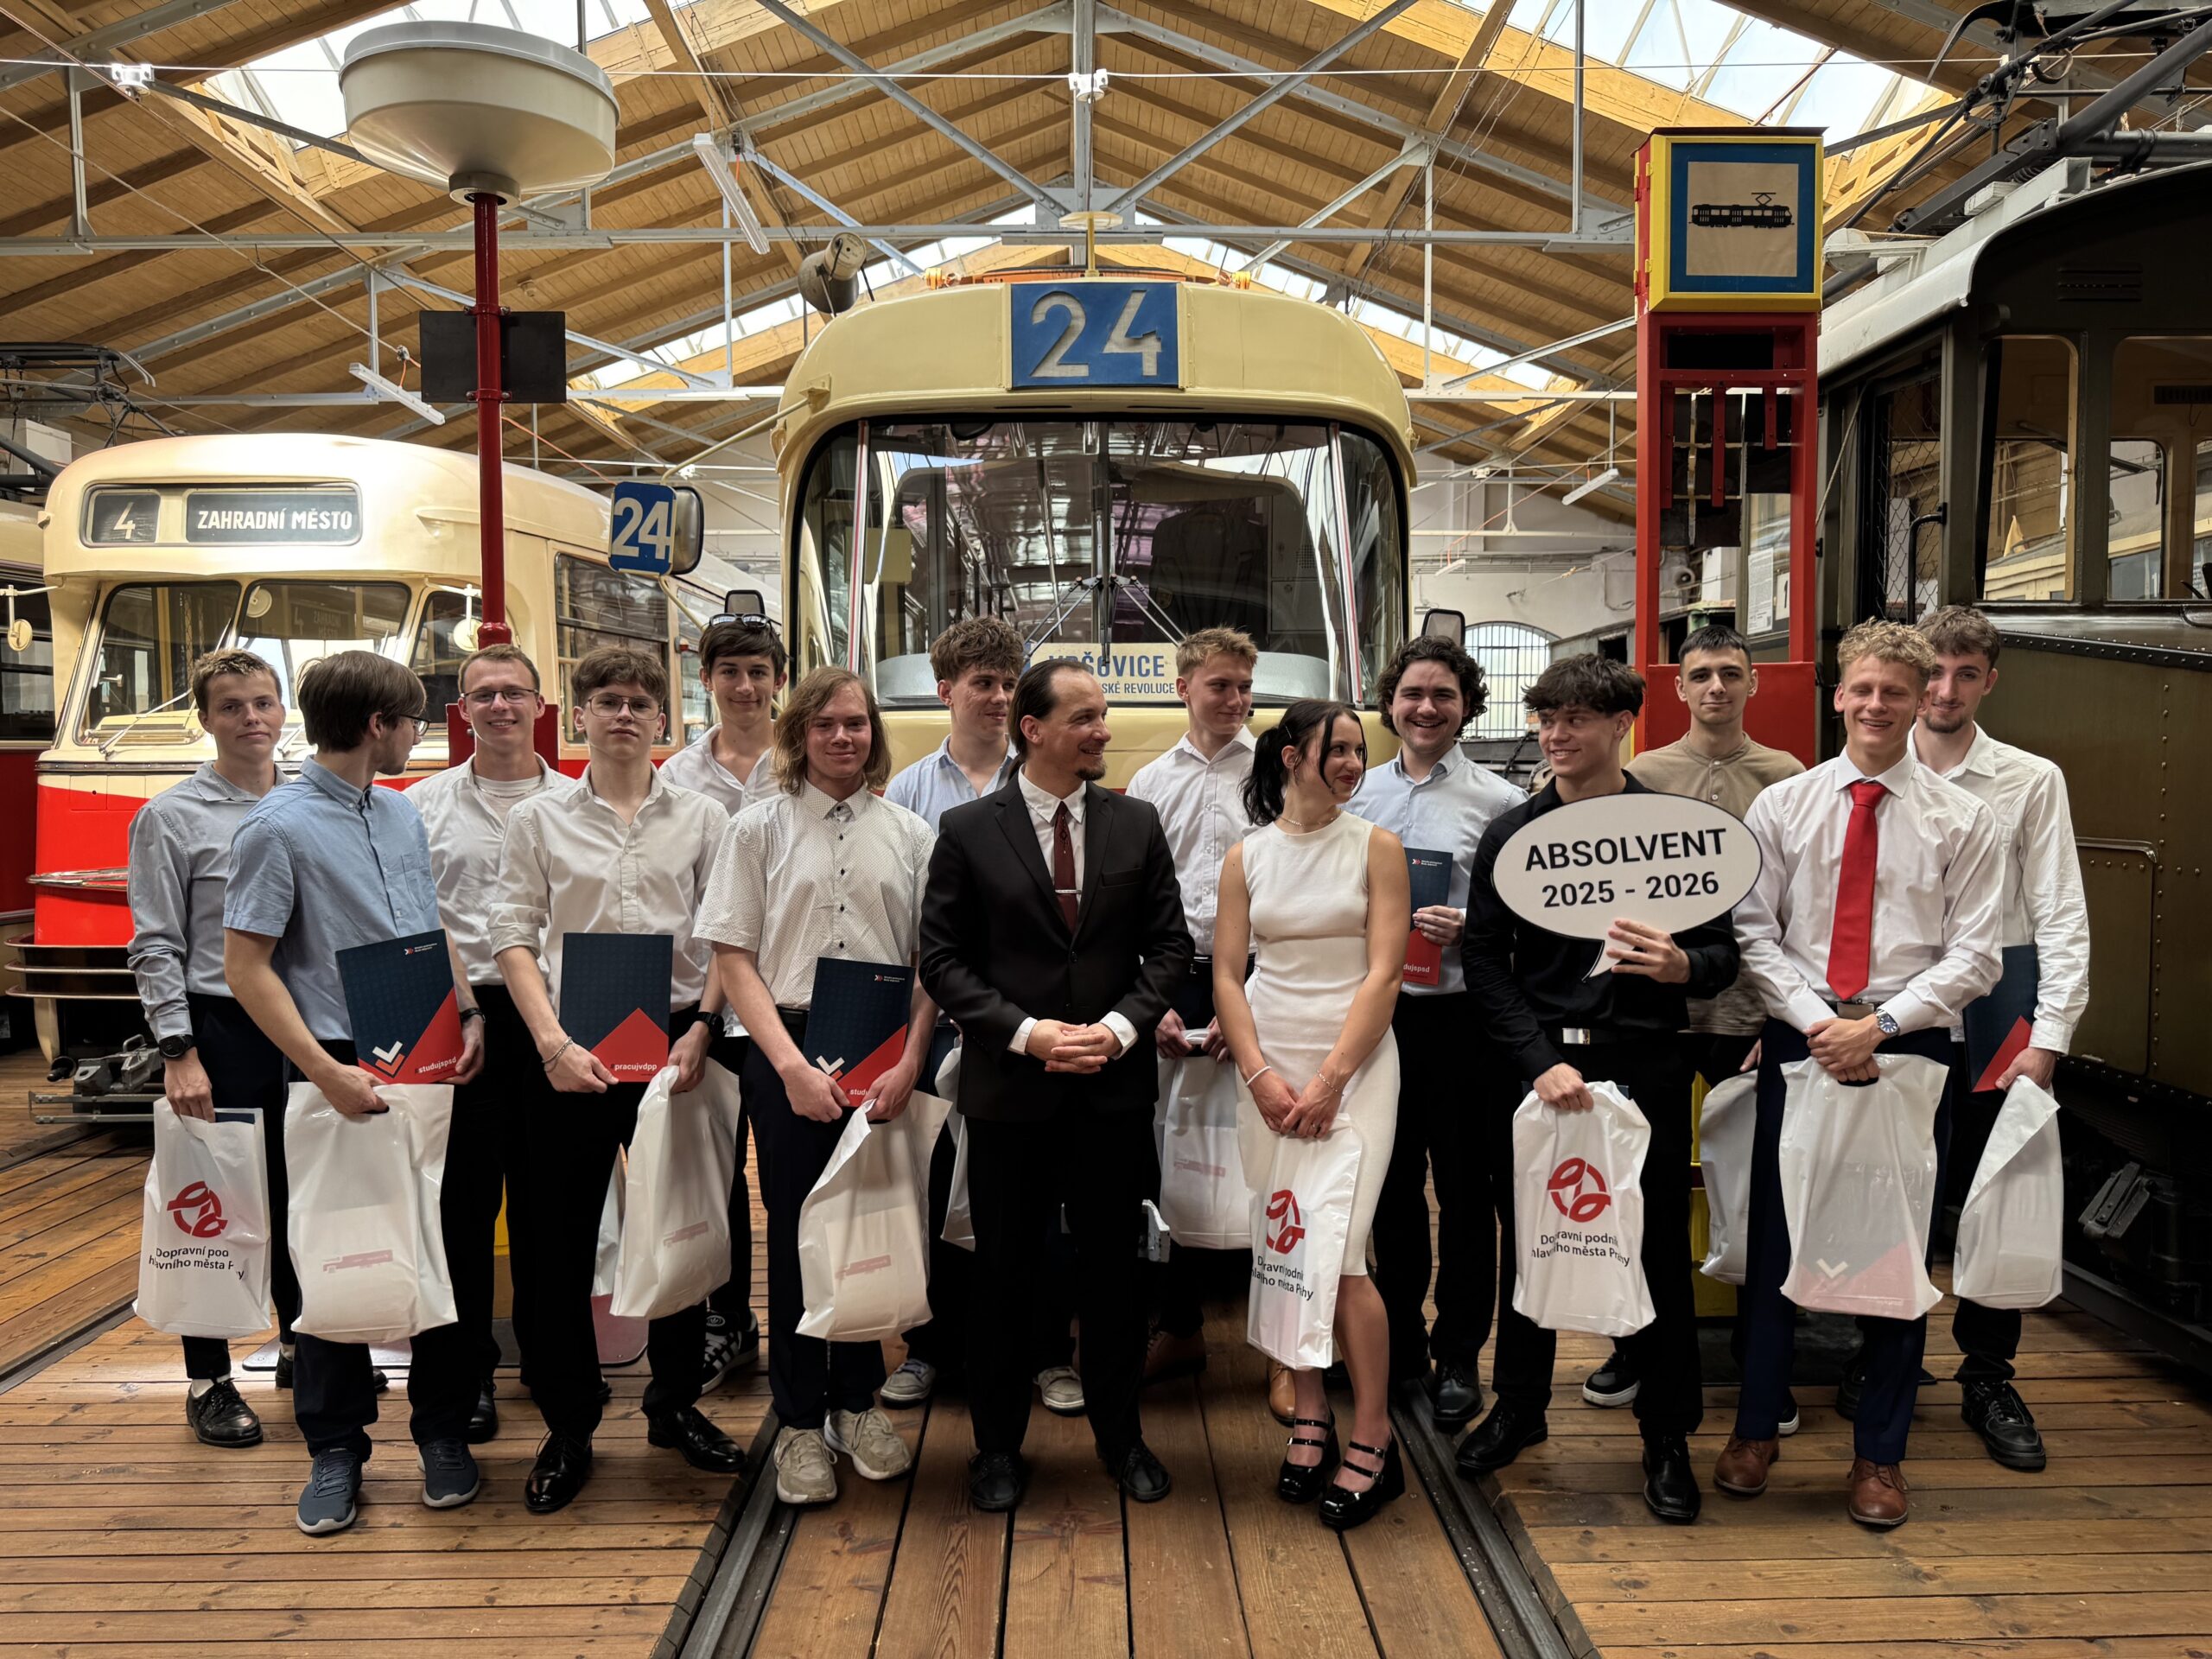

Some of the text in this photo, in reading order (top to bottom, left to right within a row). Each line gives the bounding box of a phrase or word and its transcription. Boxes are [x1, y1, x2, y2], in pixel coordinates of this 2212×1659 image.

[1030, 290, 1161, 378] 24
[113, 502, 353, 539] 4 ZAHRADNÍ MĚSTO
[611, 497, 671, 560] 24
[1049, 652, 1165, 677] ŠOVICE
[1100, 681, 1175, 694] SKÉ REVOLUCE
[1525, 828, 1726, 872] ABSOLVENT
[1541, 880, 1615, 908] 2025
[1646, 871, 1719, 899] 2026
[194, 1259, 225, 1269] města
[1572, 1246, 1606, 1257] města
